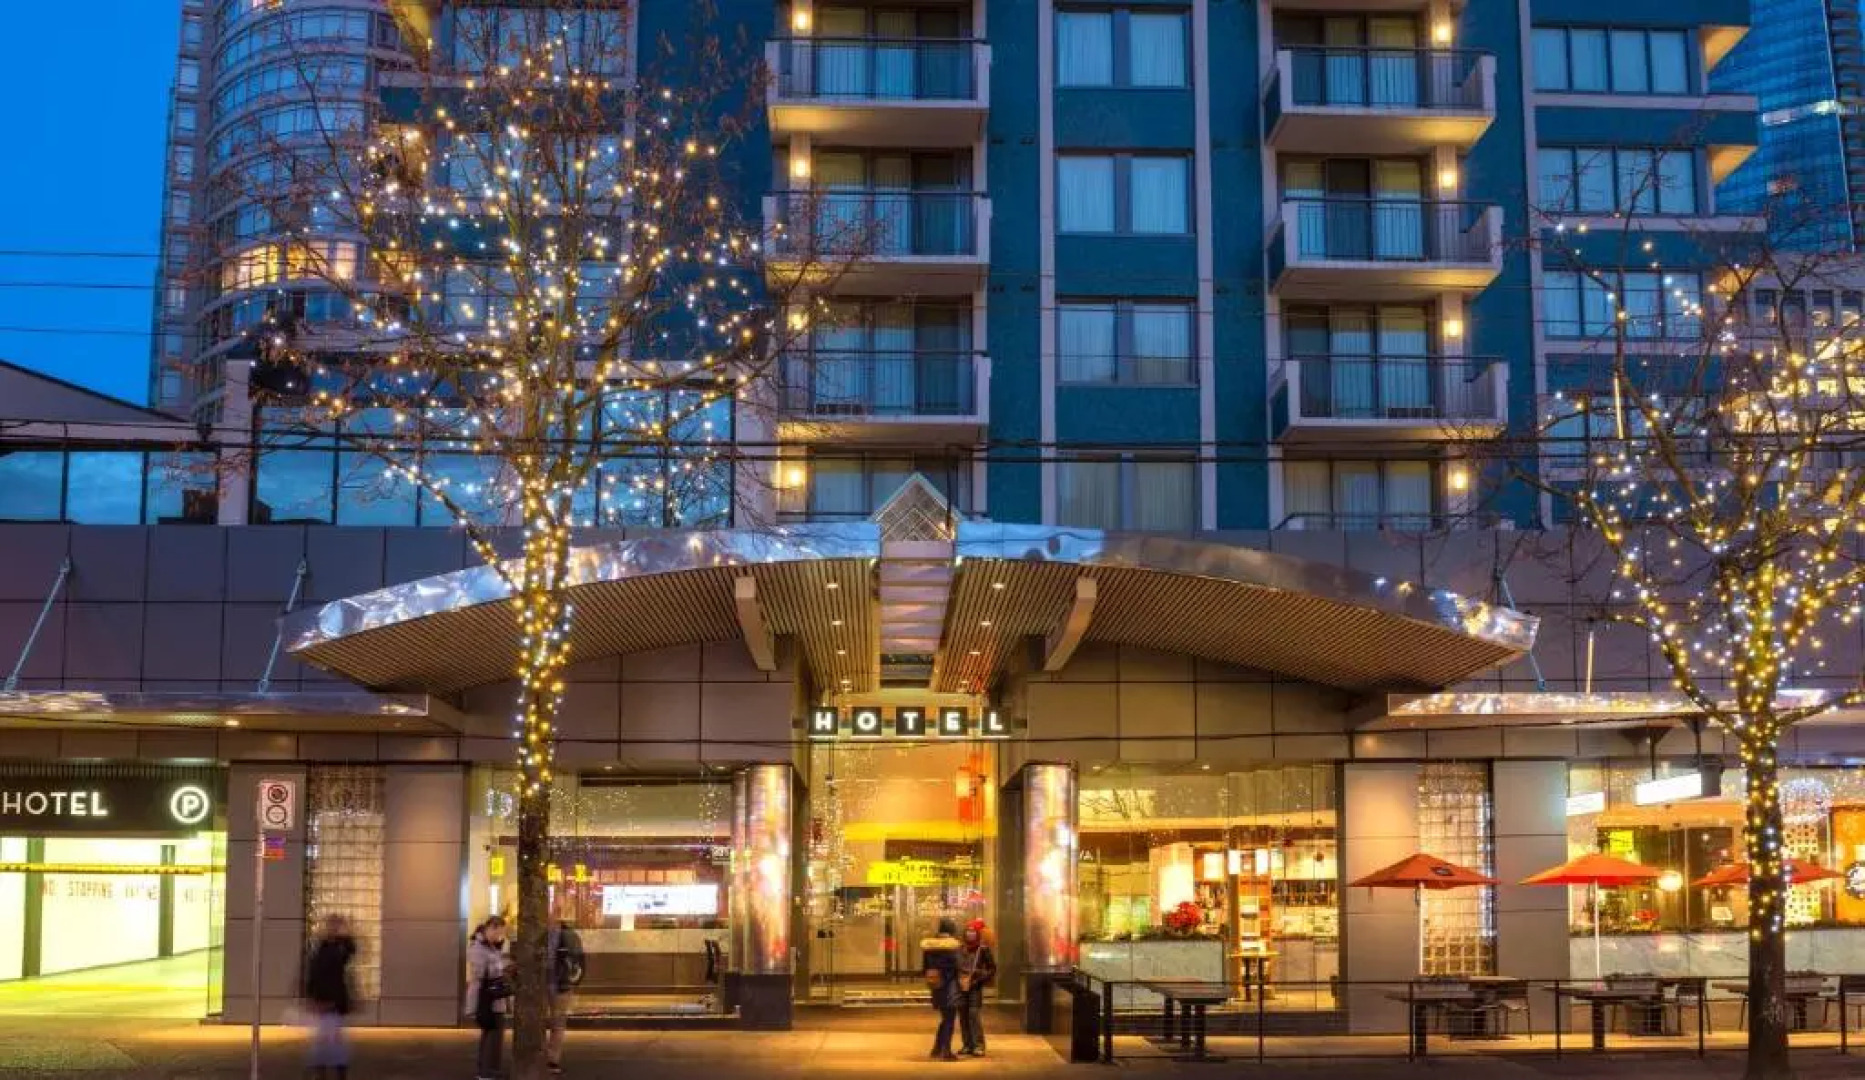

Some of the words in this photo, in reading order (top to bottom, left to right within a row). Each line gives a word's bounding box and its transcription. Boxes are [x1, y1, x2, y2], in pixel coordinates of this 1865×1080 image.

[814, 711, 1004, 731] HOTEL
[2, 791, 109, 817] HOTEL
[182, 794, 201, 817] P
